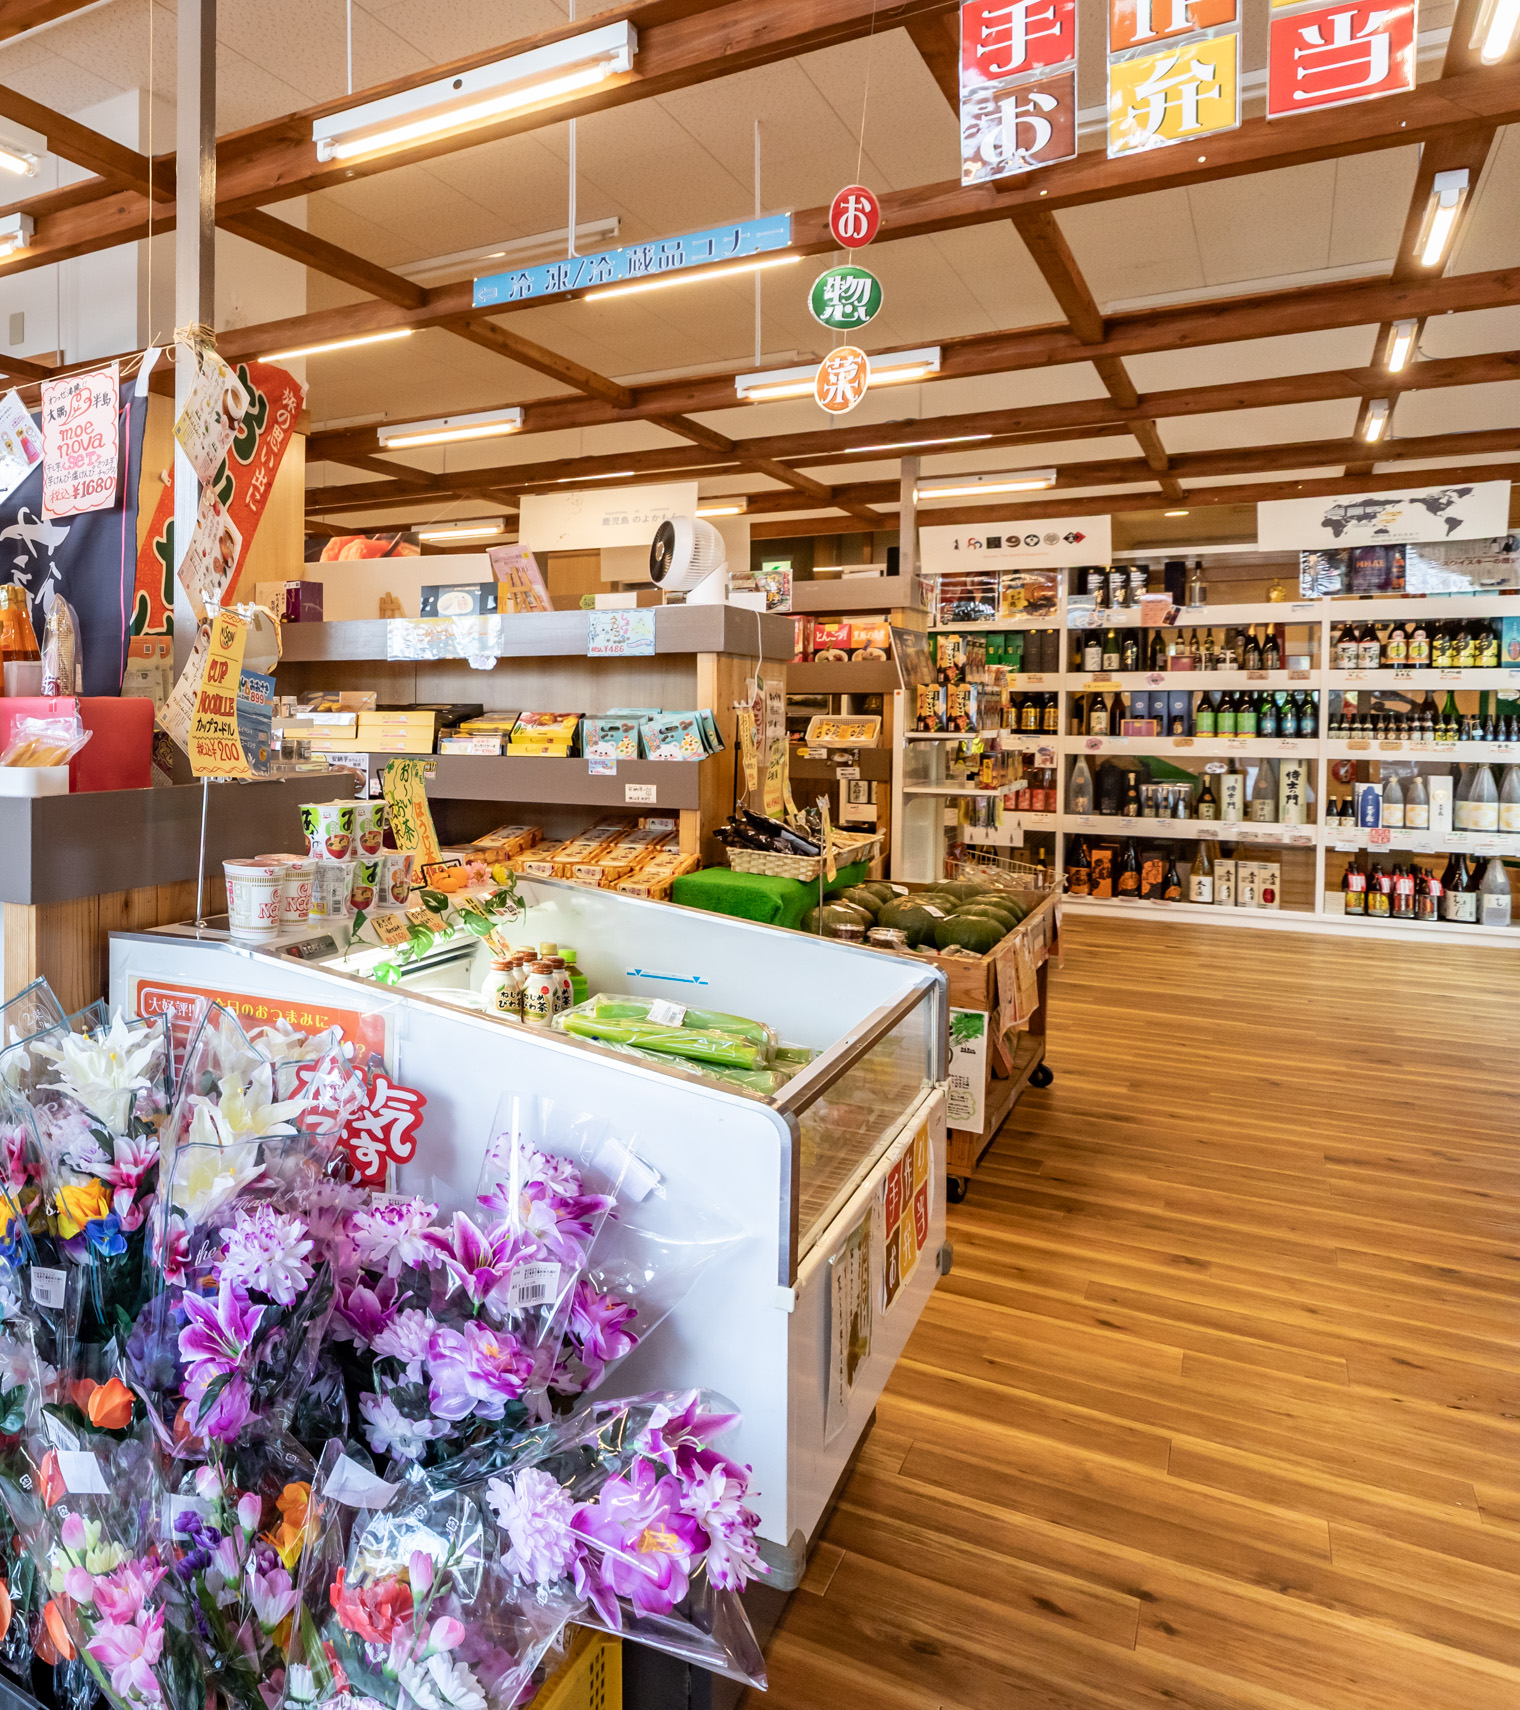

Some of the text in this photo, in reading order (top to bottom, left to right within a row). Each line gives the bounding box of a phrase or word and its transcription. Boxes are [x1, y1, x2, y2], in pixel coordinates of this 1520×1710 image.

[820, 195, 872, 404] お惣菜
[60, 421, 95, 441] moe
[57, 433, 106, 459] nova
[208, 659, 229, 684] CUP
